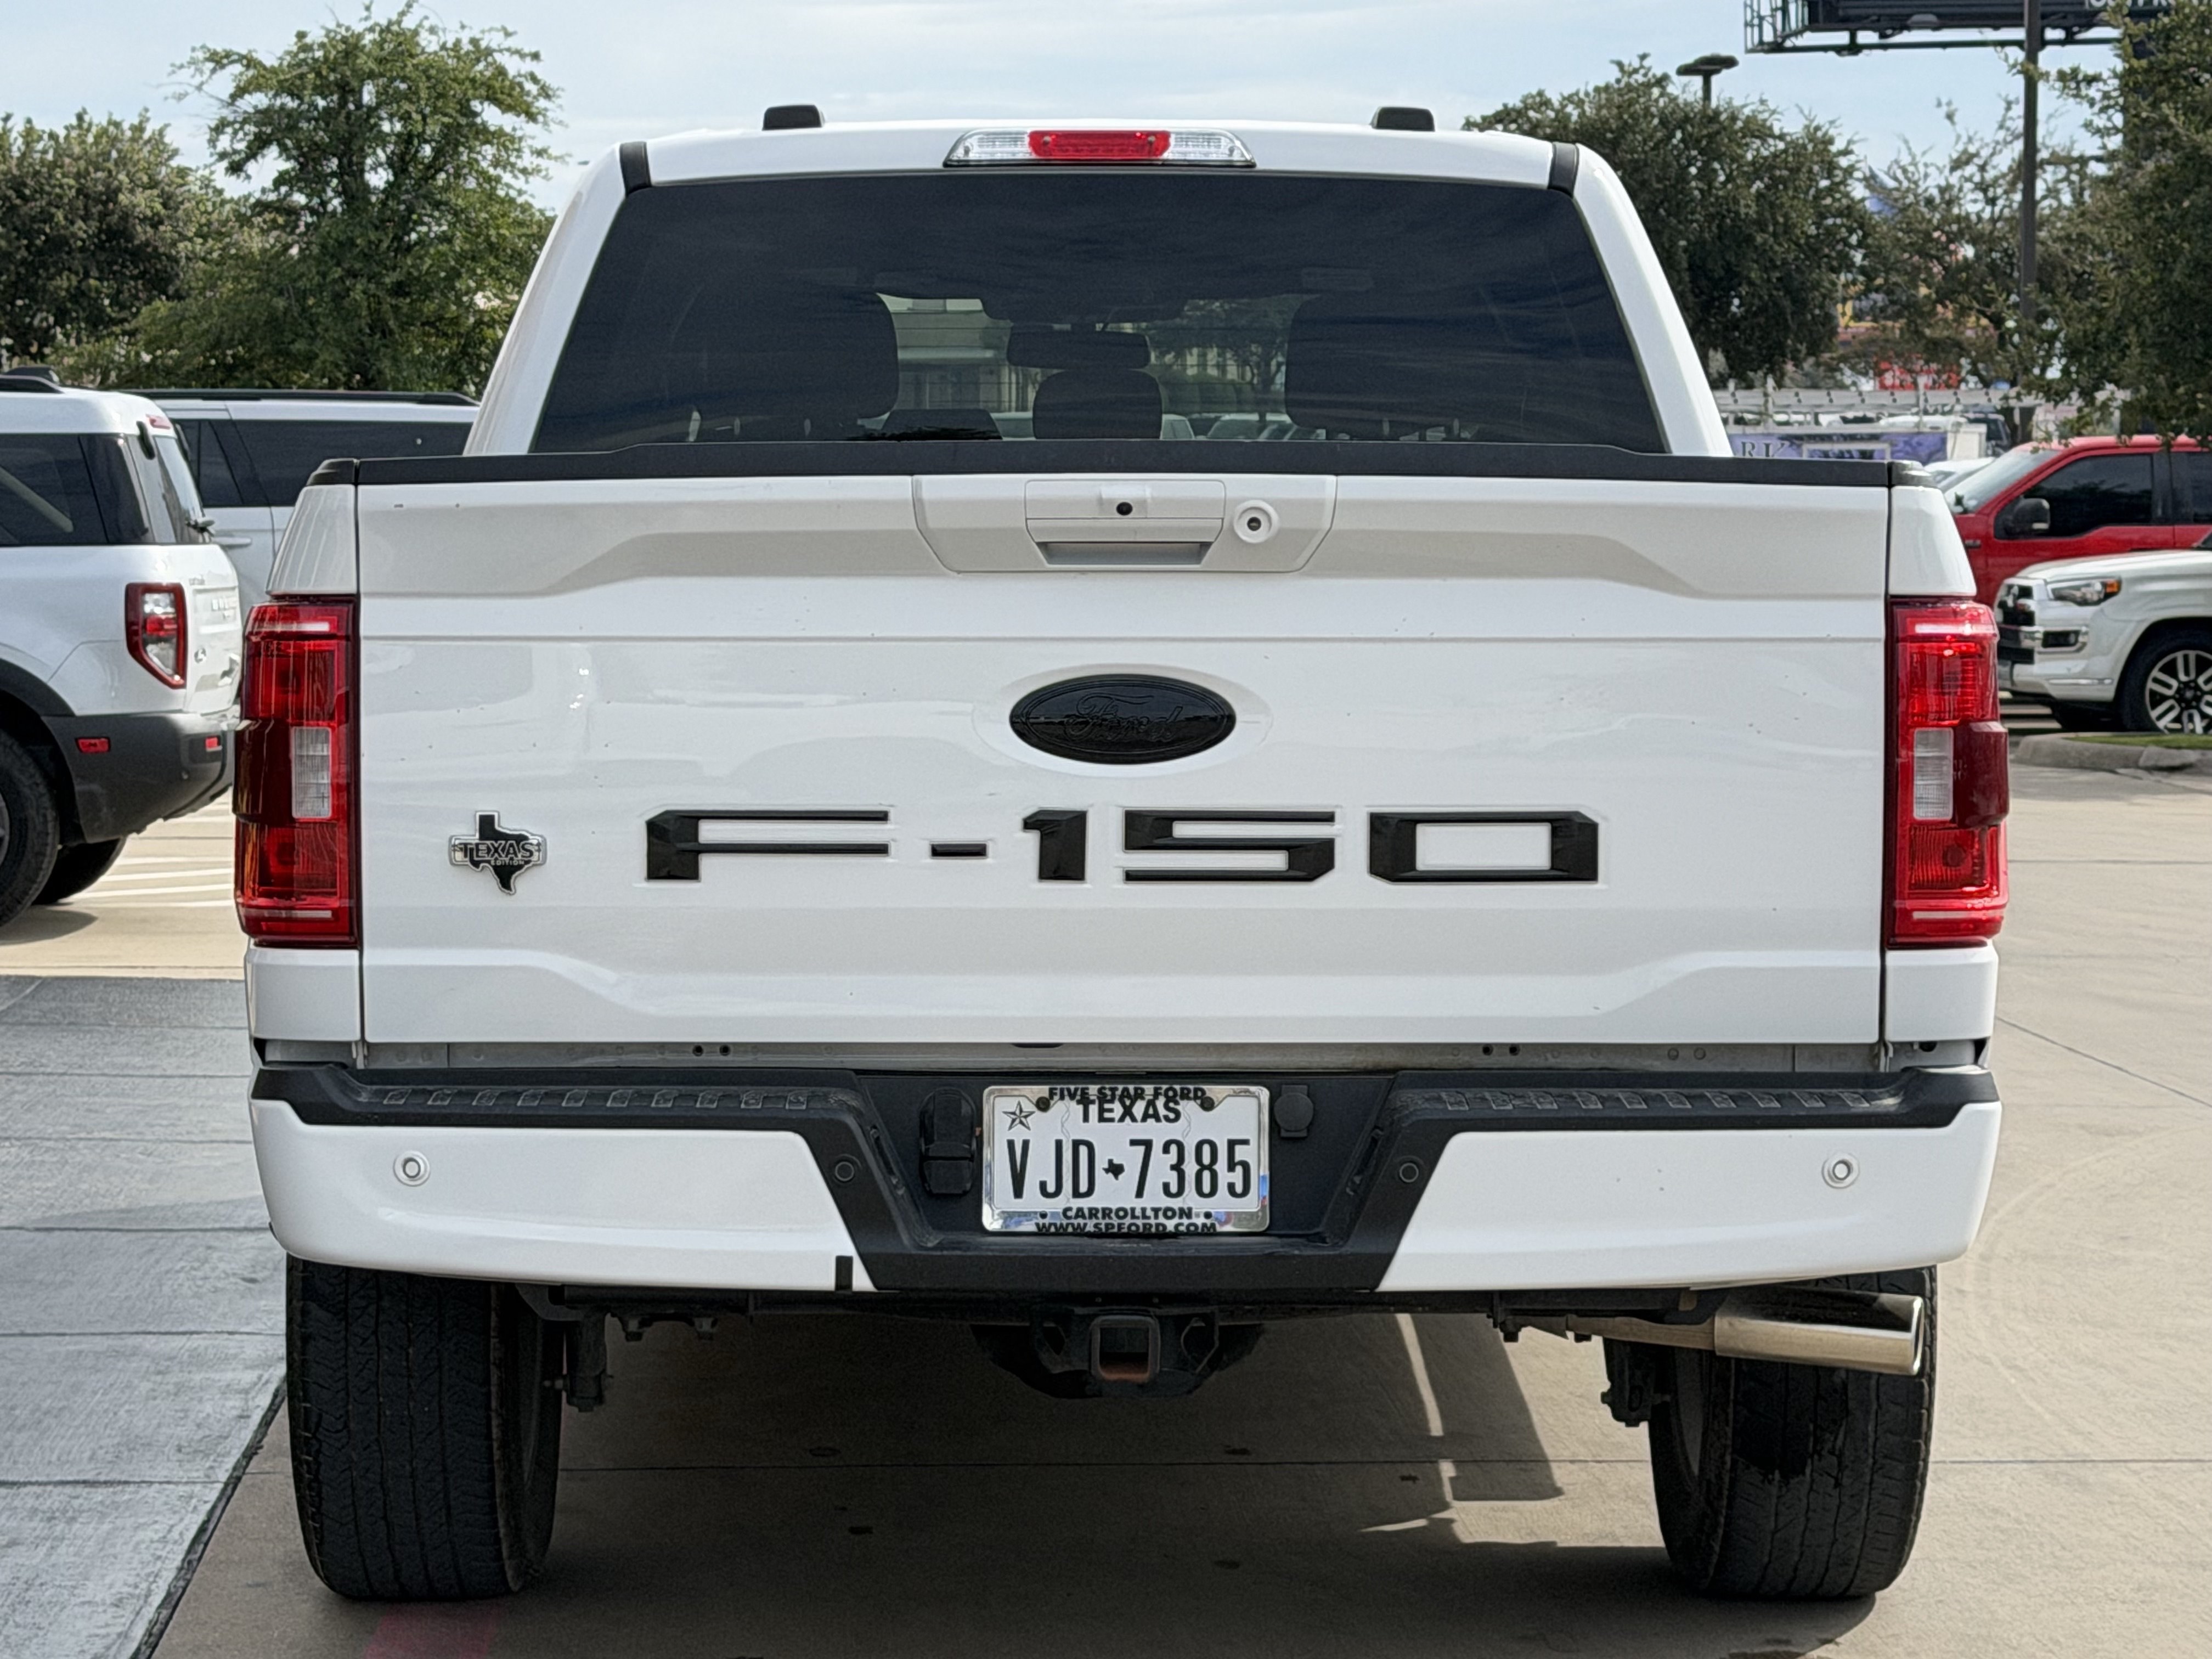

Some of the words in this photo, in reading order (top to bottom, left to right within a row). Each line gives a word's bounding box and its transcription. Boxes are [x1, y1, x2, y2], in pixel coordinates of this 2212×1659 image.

[1064, 692, 1183, 742] Ford
[458, 841, 535, 860] TEXAS
[646, 809, 1599, 883] F-150
[1048, 1086, 1090, 1101] FIVE
[1097, 1086, 1146, 1101] STAR
[1153, 1086, 1206, 1101] FORD
[1076, 1098, 1181, 1123] TEXAS
[1062, 1206, 1193, 1220] CARROLLTON
[1035, 1222, 1217, 1233] WWW.SPFORD.COM
